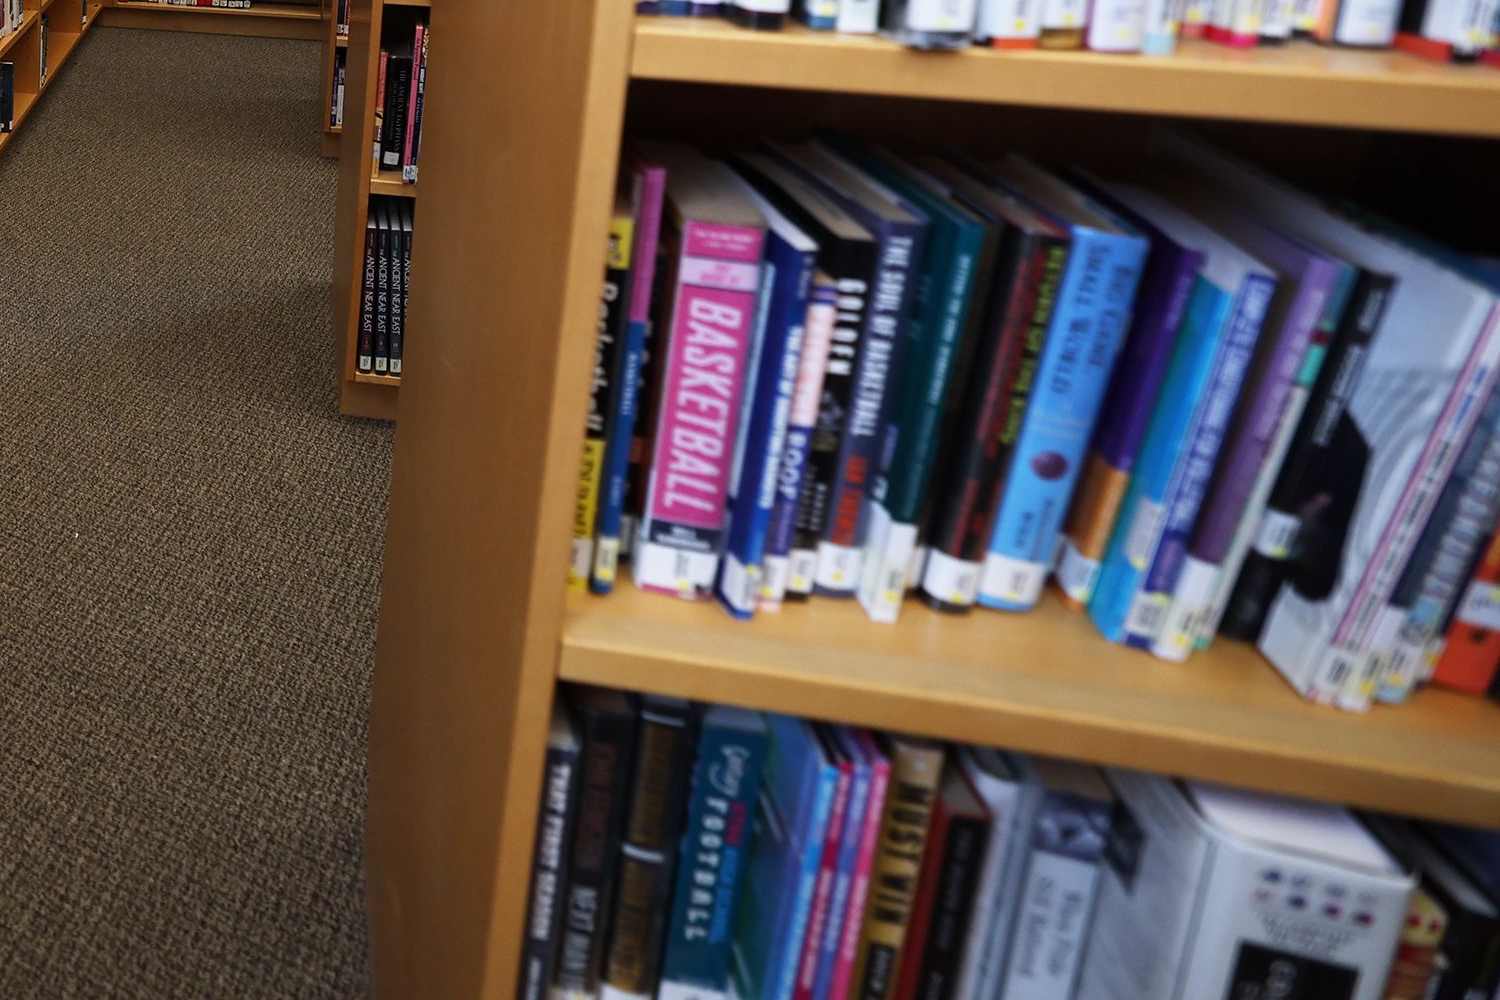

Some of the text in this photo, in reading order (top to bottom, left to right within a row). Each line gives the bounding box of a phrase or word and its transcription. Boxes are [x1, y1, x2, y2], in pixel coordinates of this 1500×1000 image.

[397, 86, 406, 112] ANCIENT
[393, 113, 404, 152] EGYPTIANS
[365, 255, 376, 290] ANCIENT
[378, 255, 388, 290] ANCIENT
[391, 256, 402, 292] ANCIENT
[364, 291, 374, 312] NEAR
[377, 291, 387, 313] NEAR
[391, 292, 401, 315] NEAR
[363, 313, 373, 333] EAST
[377, 314, 387, 334] EAST
[391, 316, 401, 336] EAST
[824, 277, 868, 376] GOLDEN
[663, 294, 744, 516] BASKETBALL
[848, 338, 894, 438] BASKETBALL
[683, 797, 730, 942] FOOTBALL
